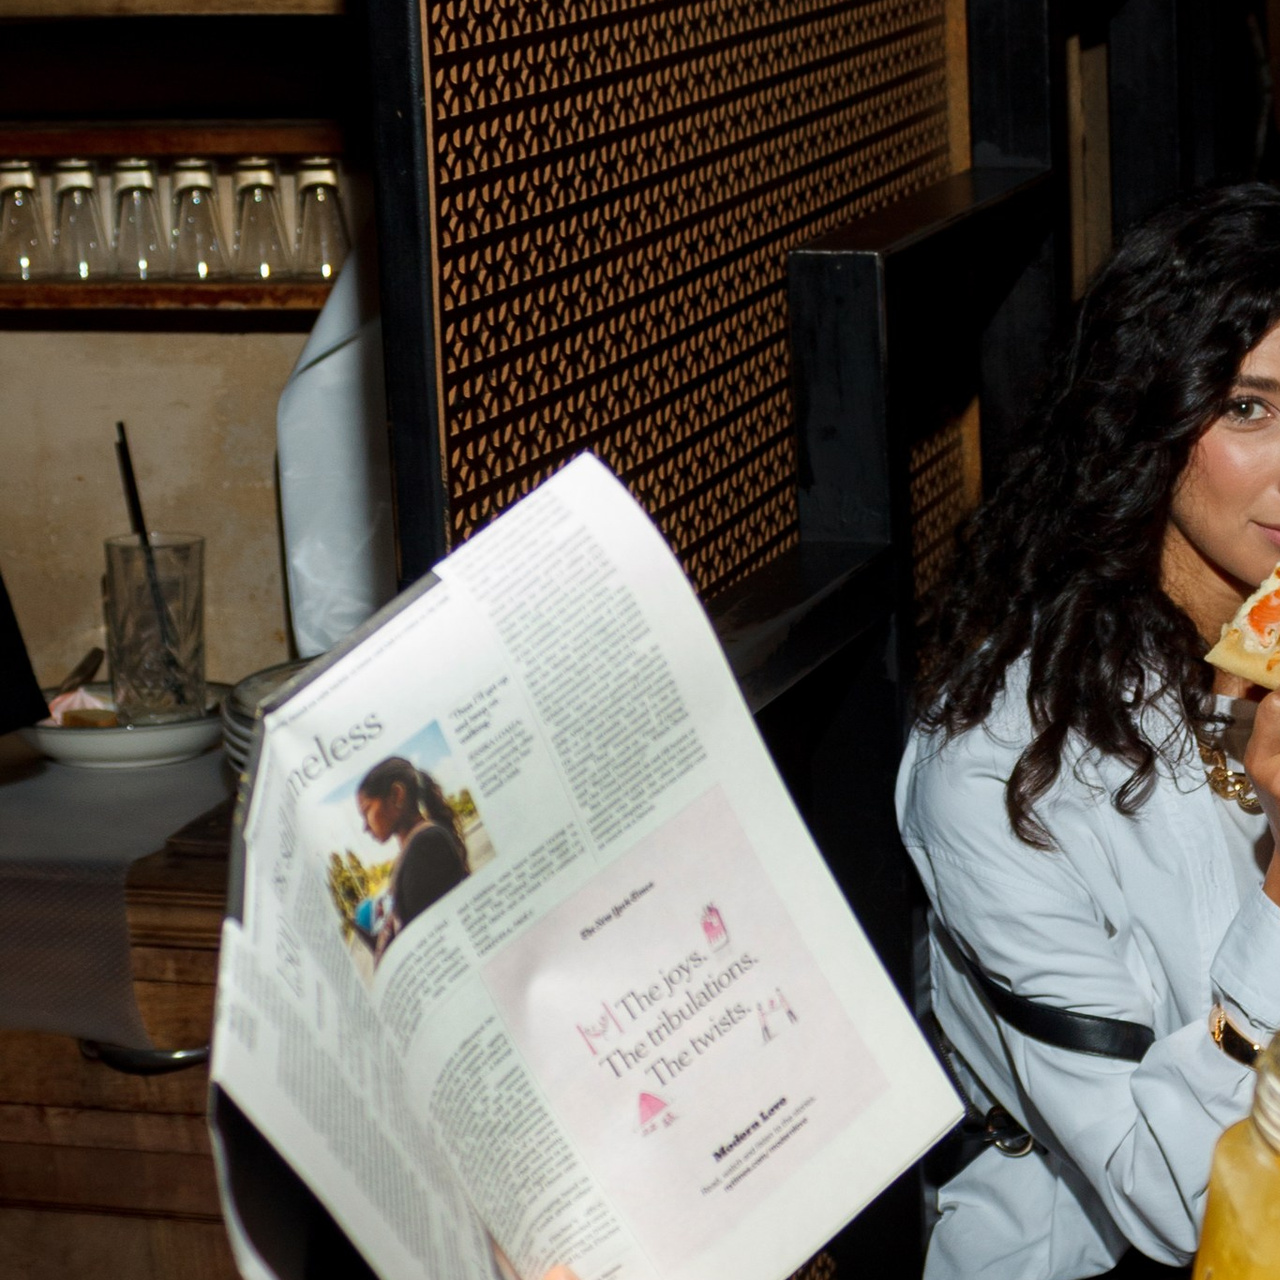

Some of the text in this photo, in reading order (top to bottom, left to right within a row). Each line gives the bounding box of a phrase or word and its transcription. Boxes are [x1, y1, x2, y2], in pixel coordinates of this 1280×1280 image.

[579, 881, 654, 940] The New York Times
[597, 952, 759, 1079] The tribulations.
[614, 950, 708, 1021] The joys.
[643, 1002, 752, 1087] The twists.
[712, 1096, 787, 1162] Modern Love
